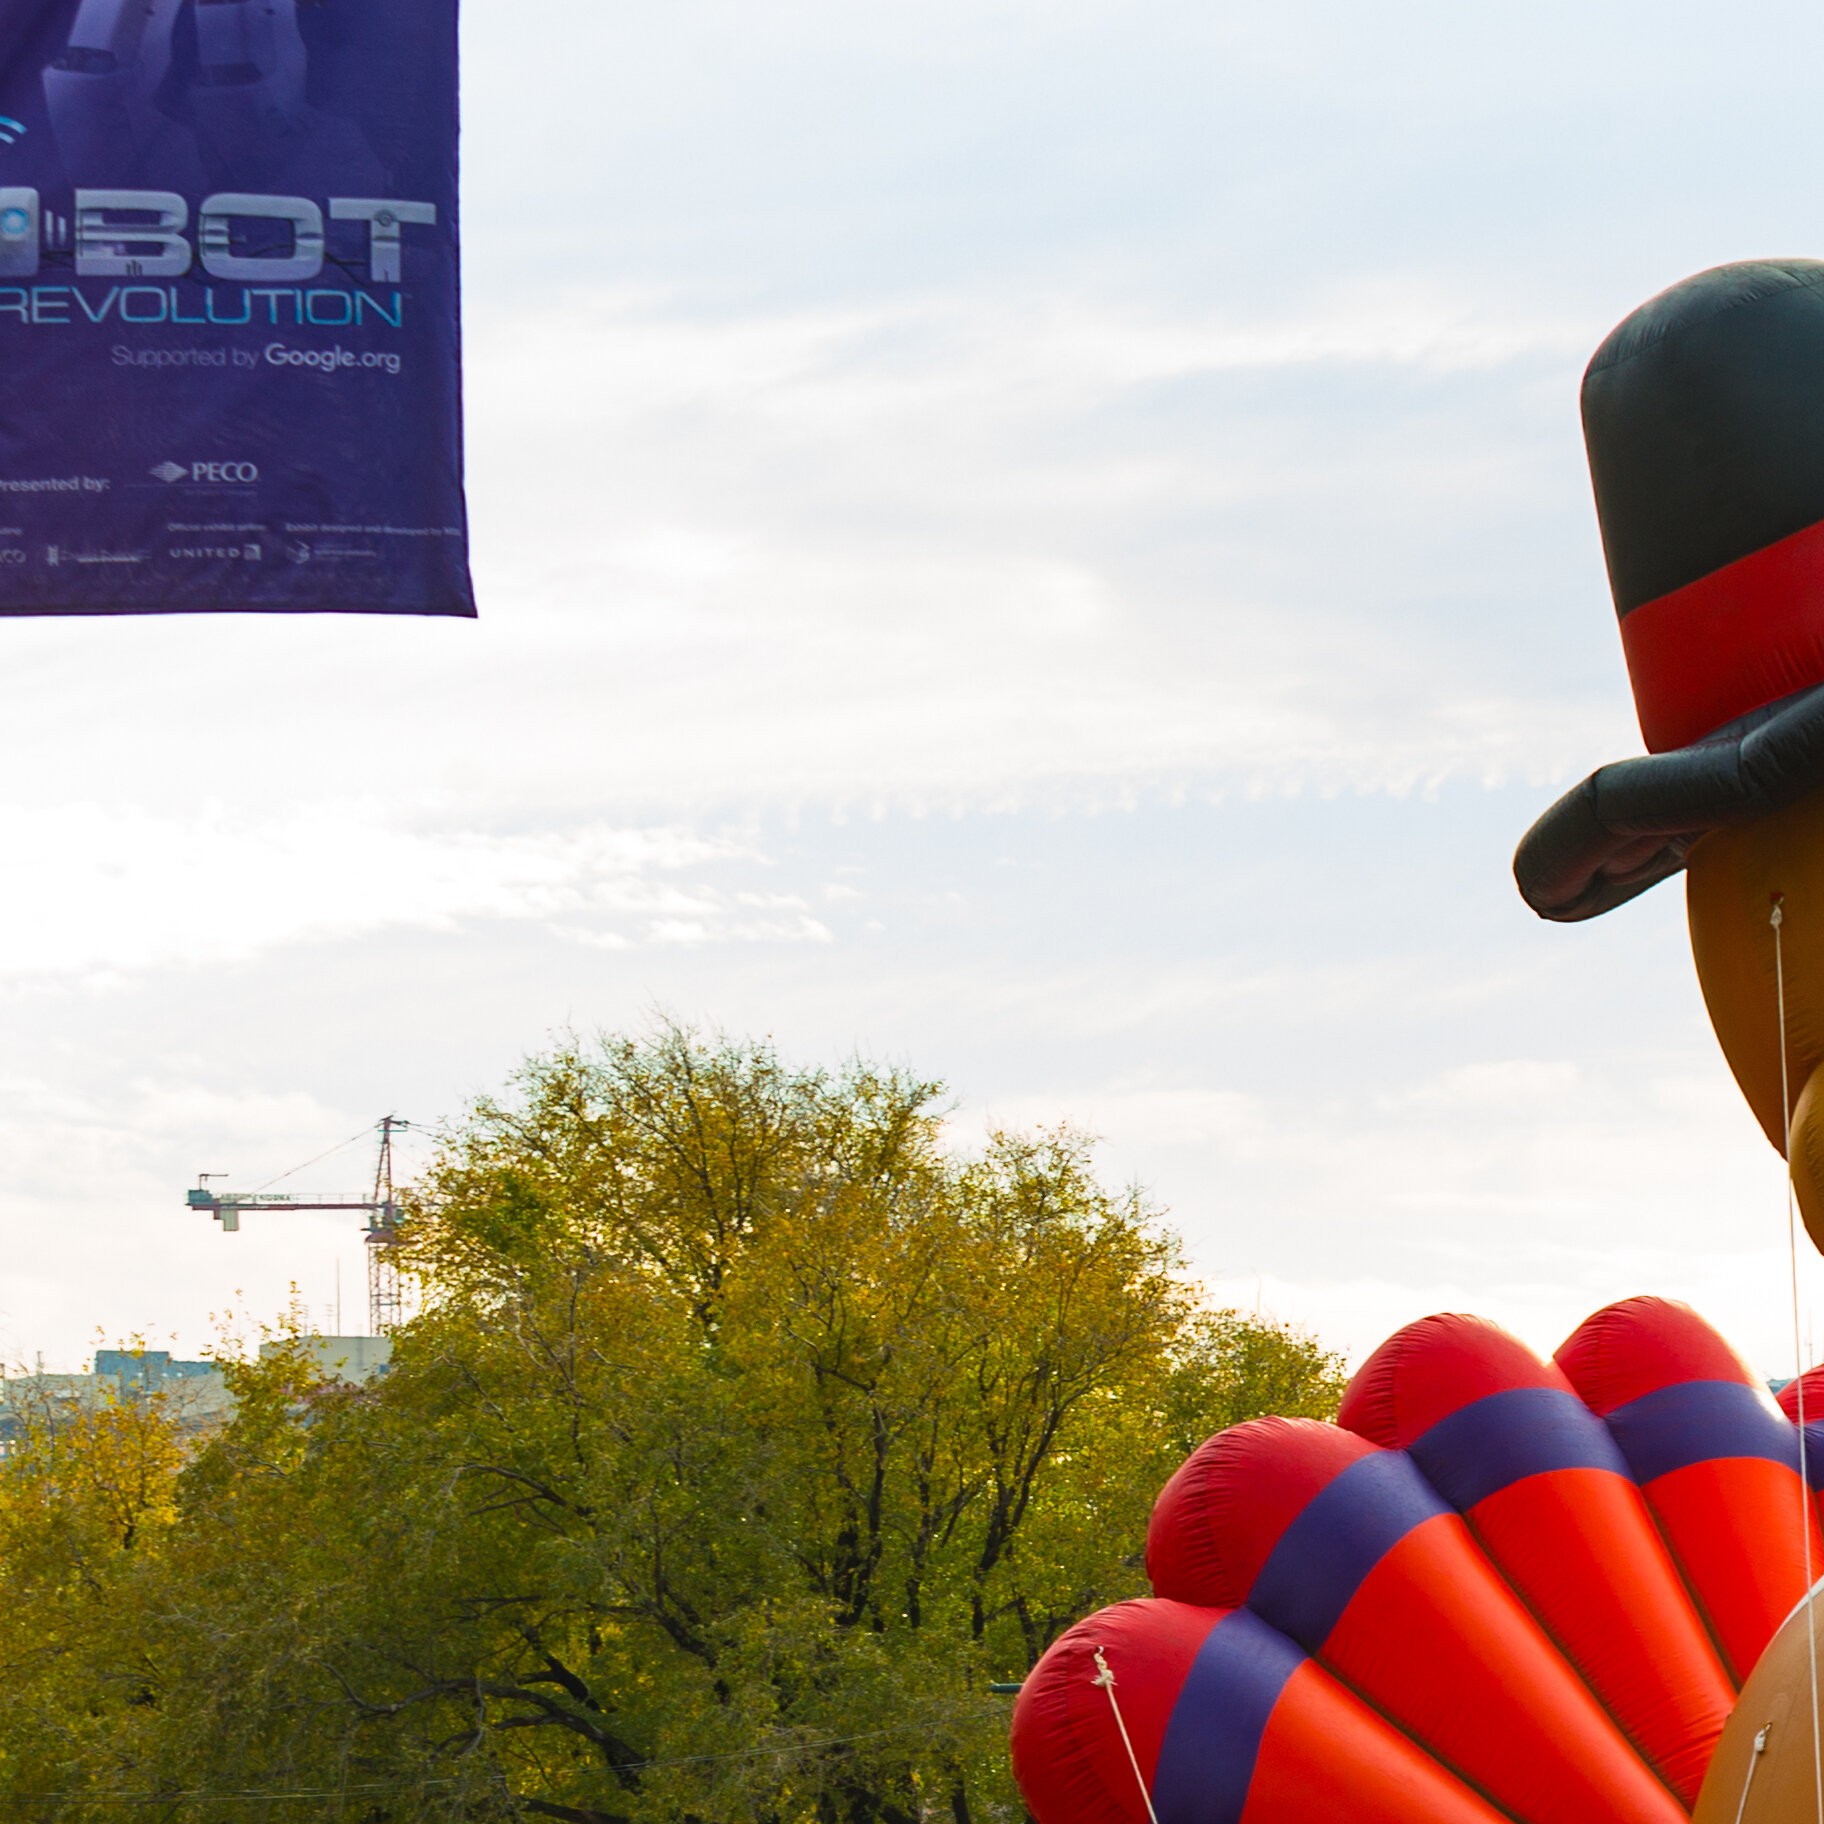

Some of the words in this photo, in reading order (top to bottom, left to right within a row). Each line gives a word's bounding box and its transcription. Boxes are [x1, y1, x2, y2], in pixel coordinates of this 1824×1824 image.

[0, 285, 402, 328] REVOLUTION
[112, 345, 226, 368] Supported
[233, 346, 260, 369] by
[265, 343, 400, 374] Google.org
[192, 462, 258, 482] PECO
[83, 475, 110, 492] by:
[170, 548, 241, 559] UNITED
